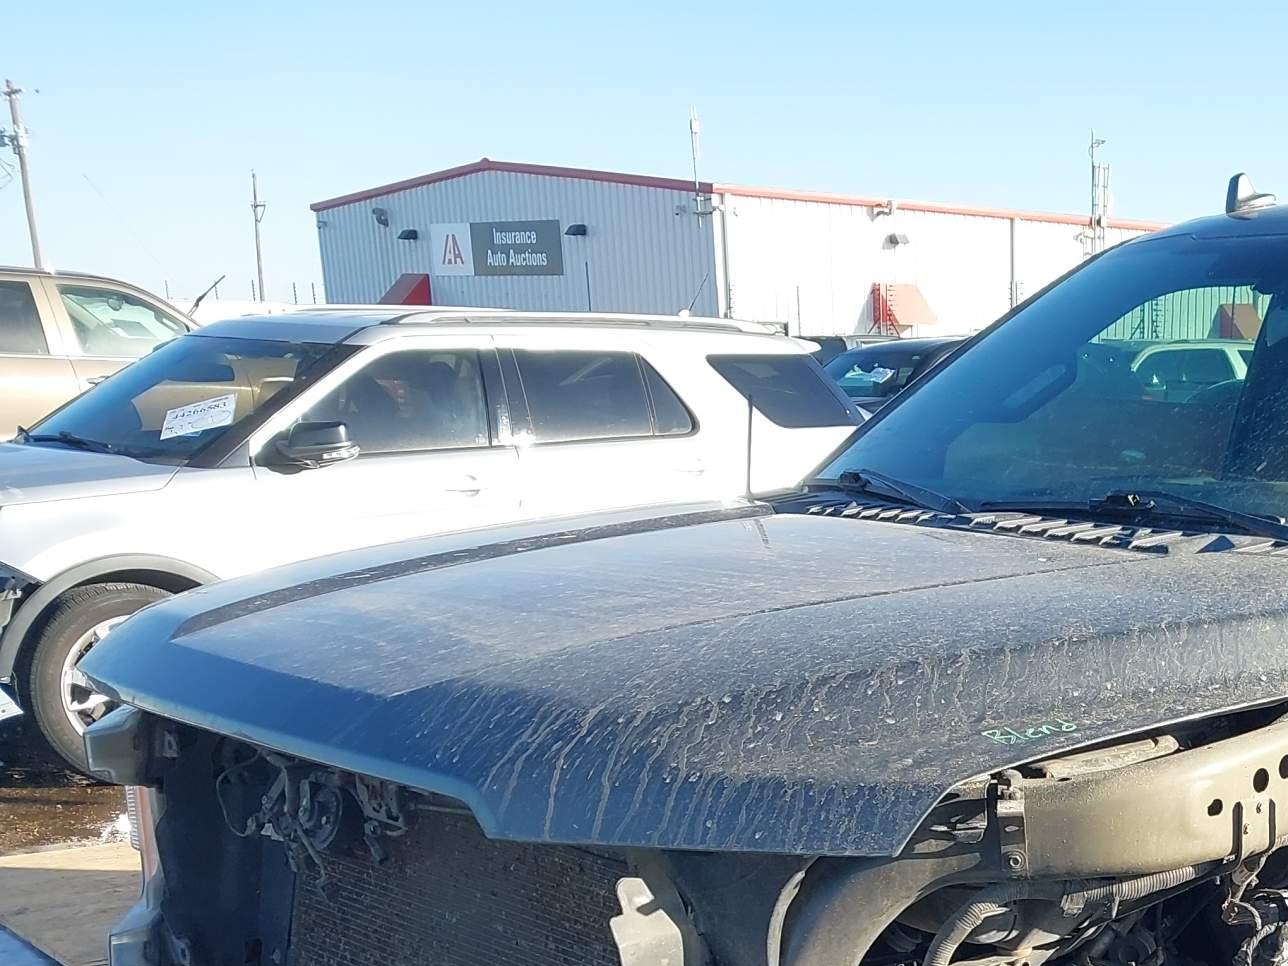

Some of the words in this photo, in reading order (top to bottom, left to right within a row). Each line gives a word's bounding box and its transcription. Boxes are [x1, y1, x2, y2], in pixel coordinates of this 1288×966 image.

[492, 227, 537, 245] Insurance
[487, 250, 507, 267] Auto
[509, 249, 548, 267] Auctions
